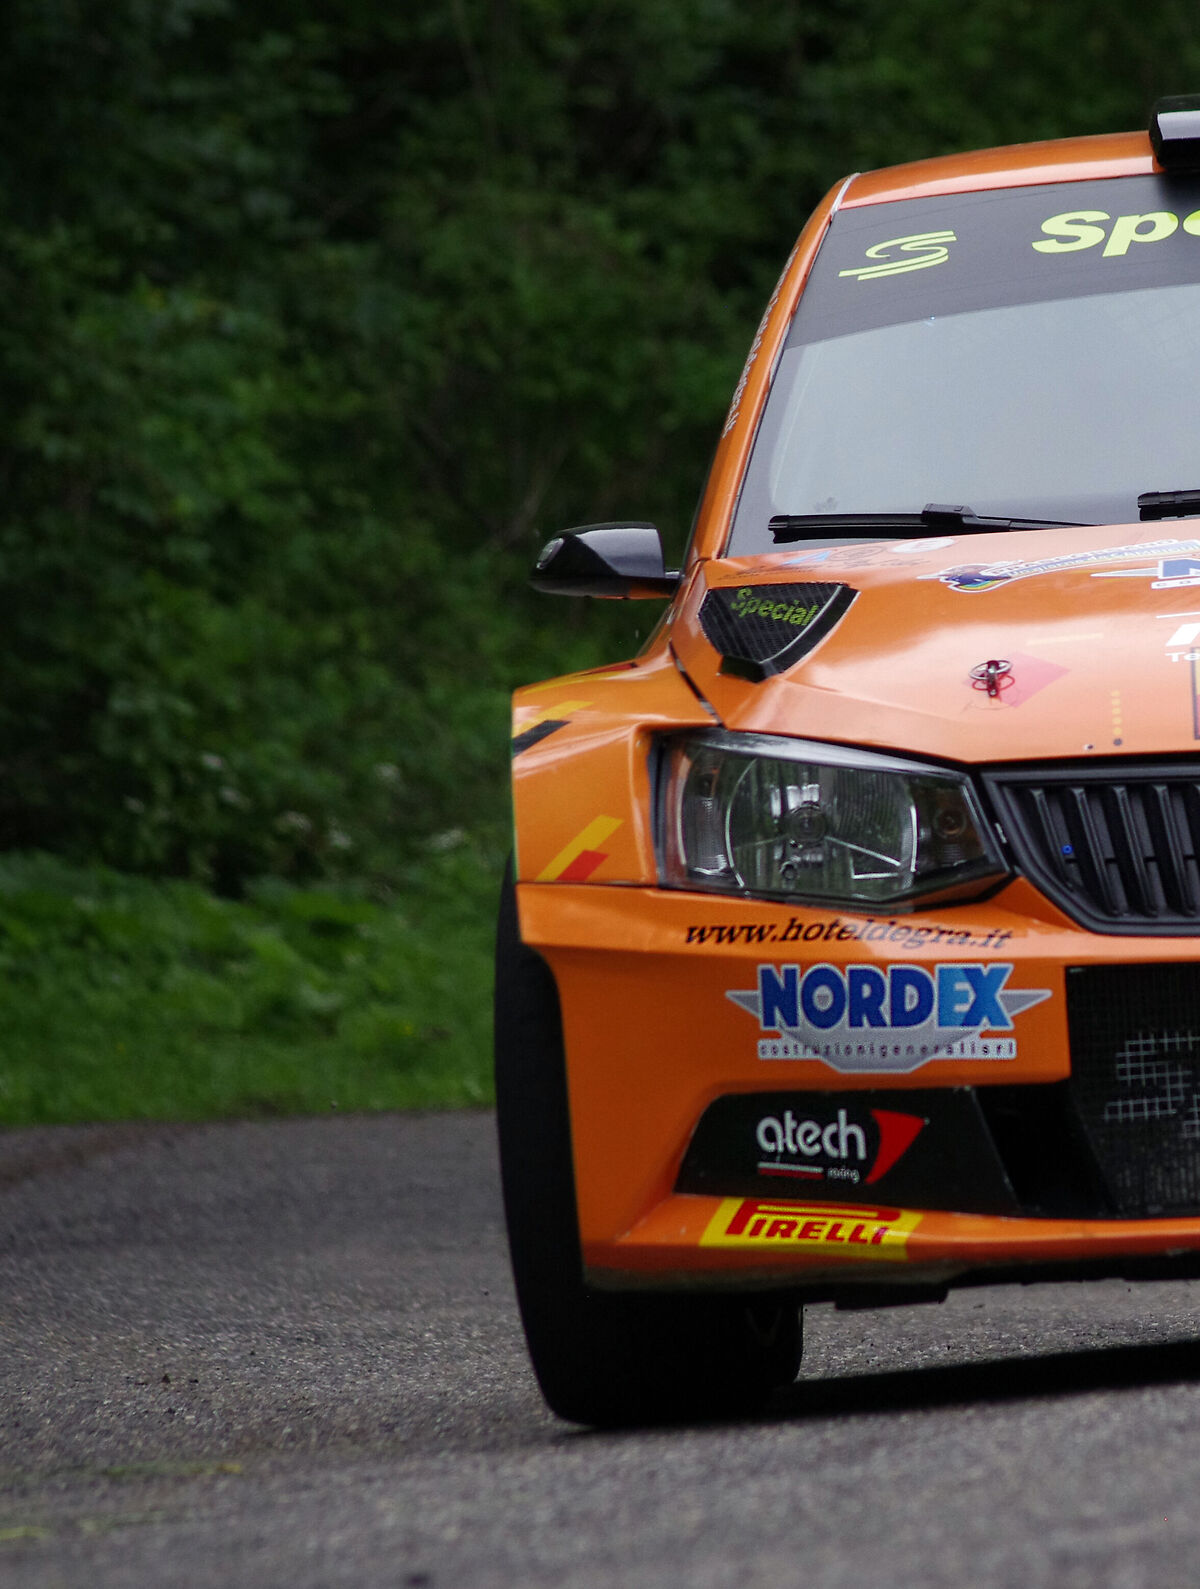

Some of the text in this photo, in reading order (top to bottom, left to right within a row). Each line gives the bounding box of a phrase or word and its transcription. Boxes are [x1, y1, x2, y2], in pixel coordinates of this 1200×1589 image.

[730, 587, 819, 626] Special
[757, 963, 1013, 1031] NORDEX
[755, 1108, 867, 1161] atech
[724, 1198, 903, 1246] PIRELLI
